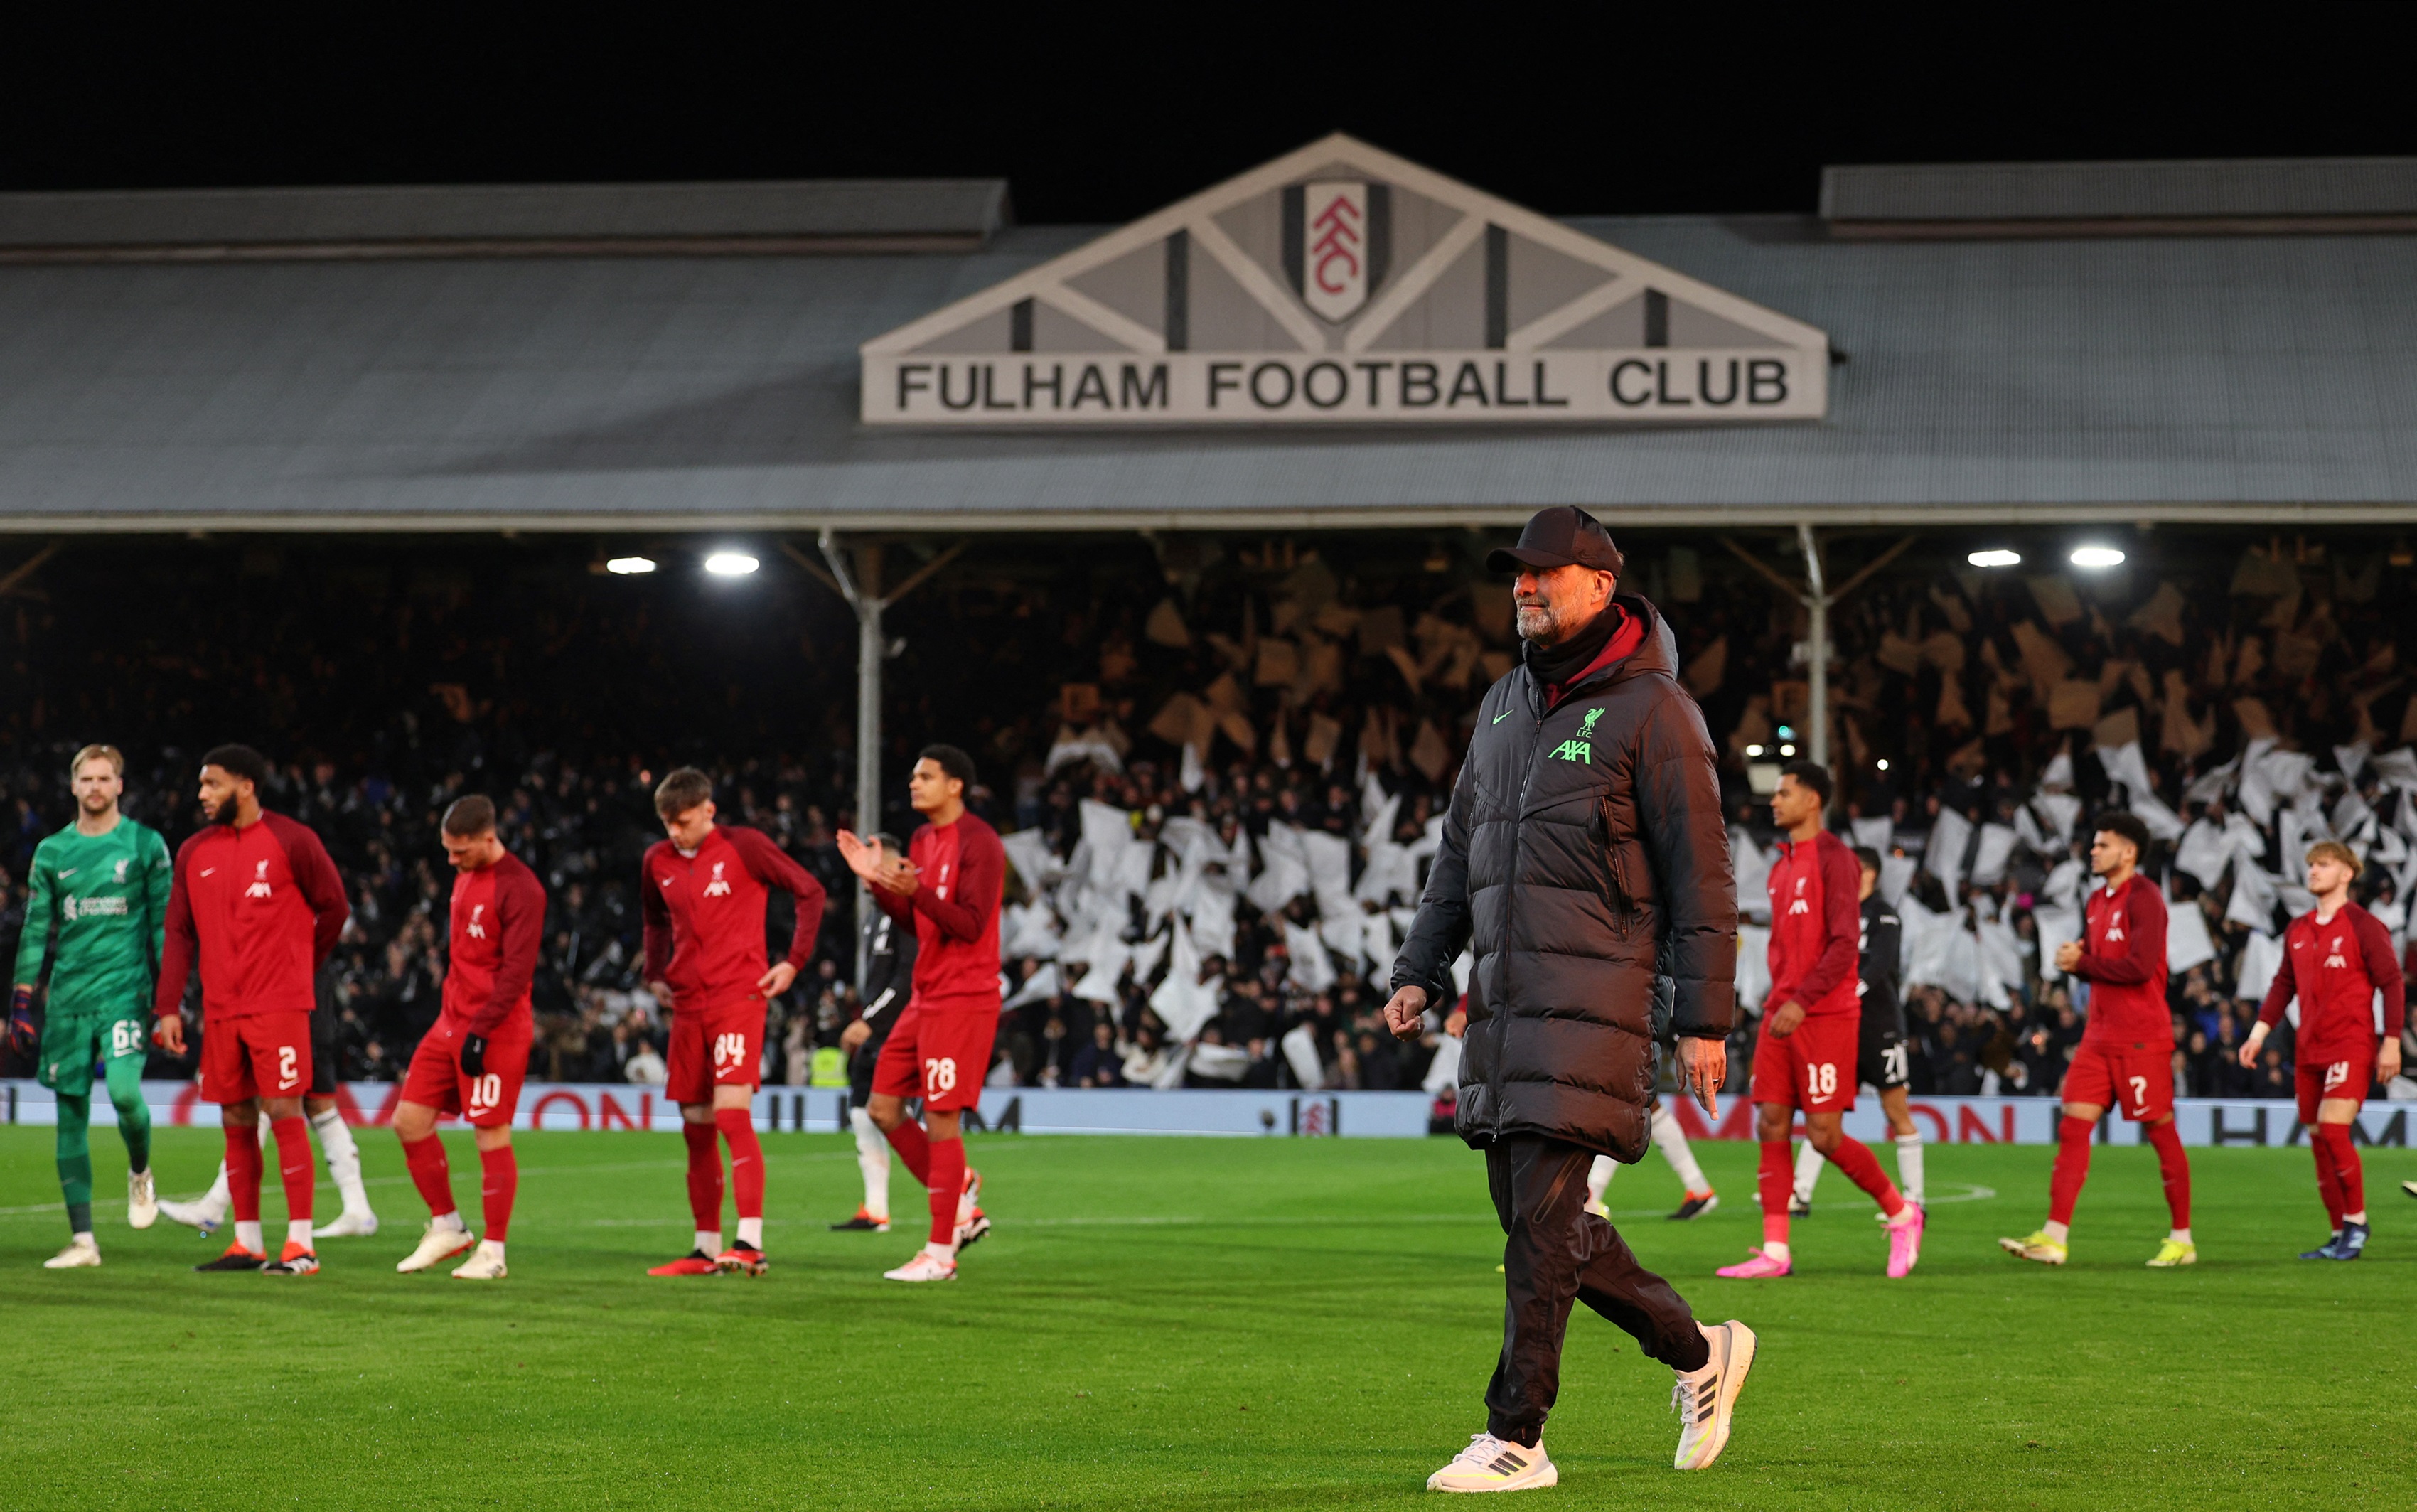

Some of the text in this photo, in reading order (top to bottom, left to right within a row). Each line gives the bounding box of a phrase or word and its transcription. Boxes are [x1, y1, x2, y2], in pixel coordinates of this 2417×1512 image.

[896, 358, 1789, 411] FULHAM FOOTBALL CLUB
[1548, 739, 1591, 765] AXA
[278, 1045, 299, 1080] 2
[713, 1032, 746, 1067] 84
[470, 1072, 502, 1108] 10
[925, 1057, 957, 1092] 78
[1806, 1062, 1838, 1095] 18
[2128, 1075, 2148, 1106] 7
